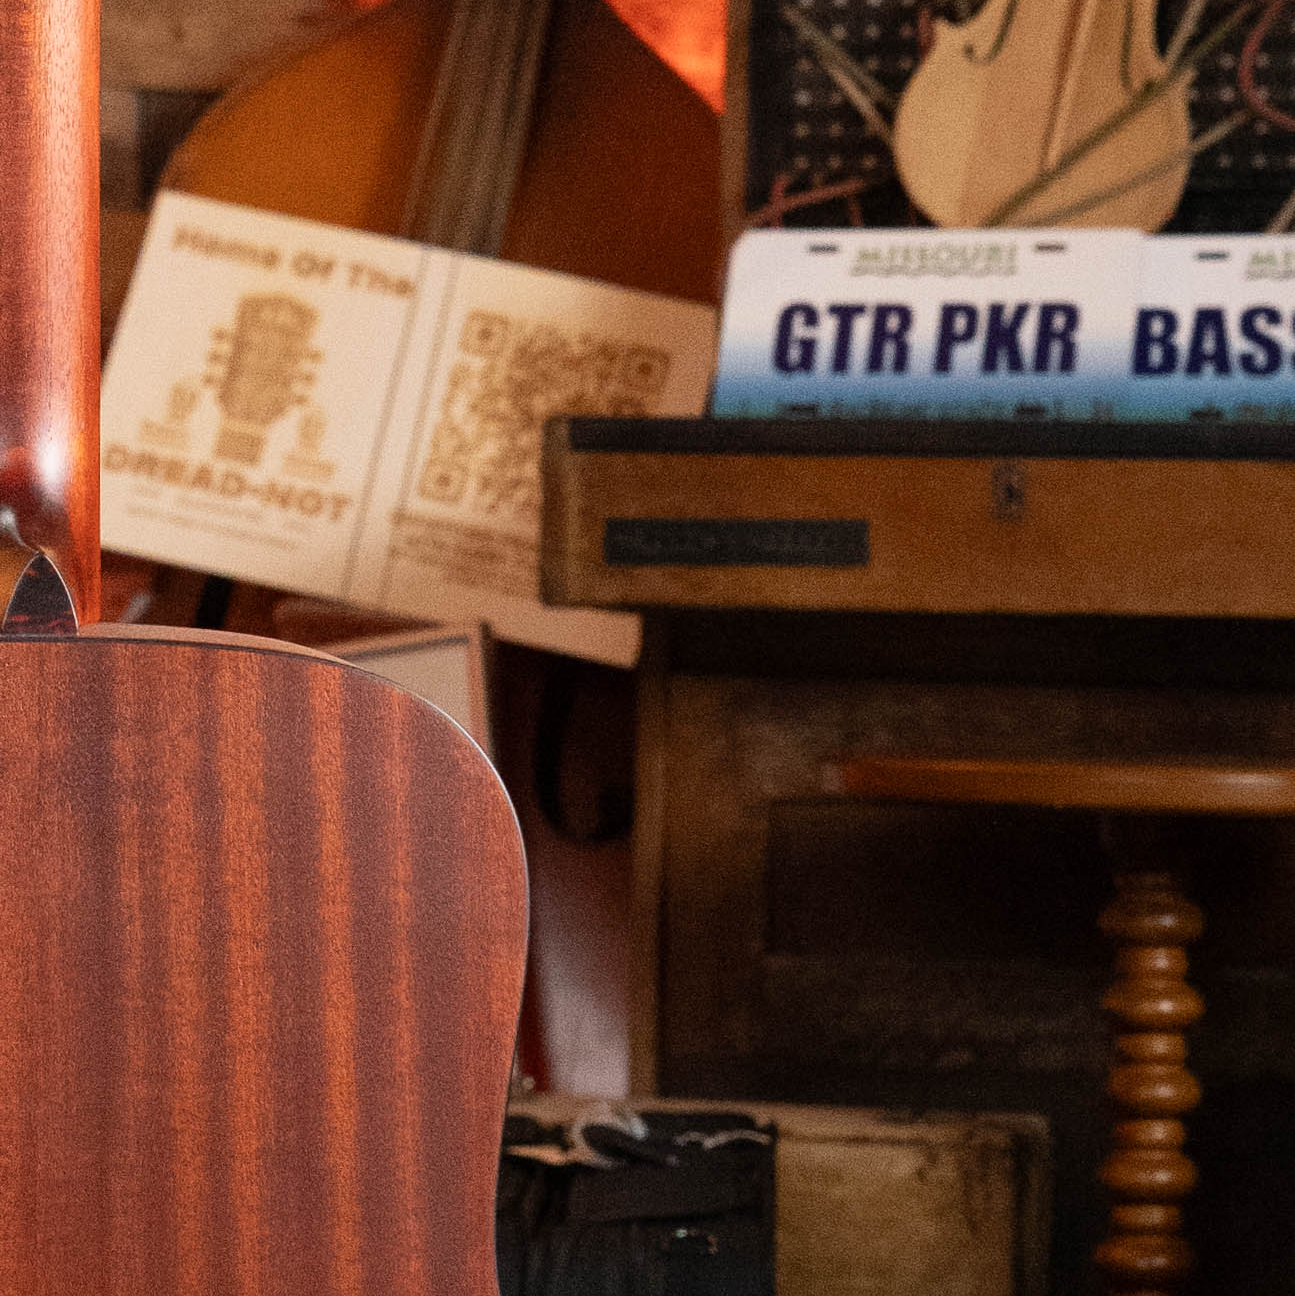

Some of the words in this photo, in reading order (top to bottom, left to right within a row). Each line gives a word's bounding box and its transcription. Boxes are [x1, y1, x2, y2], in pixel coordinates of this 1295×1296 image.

[772, 302, 914, 375] GTR
[932, 302, 1082, 375] PKR
[1135, 305, 1295, 378] BAS
[103, 445, 351, 521] DREAD-NOT
